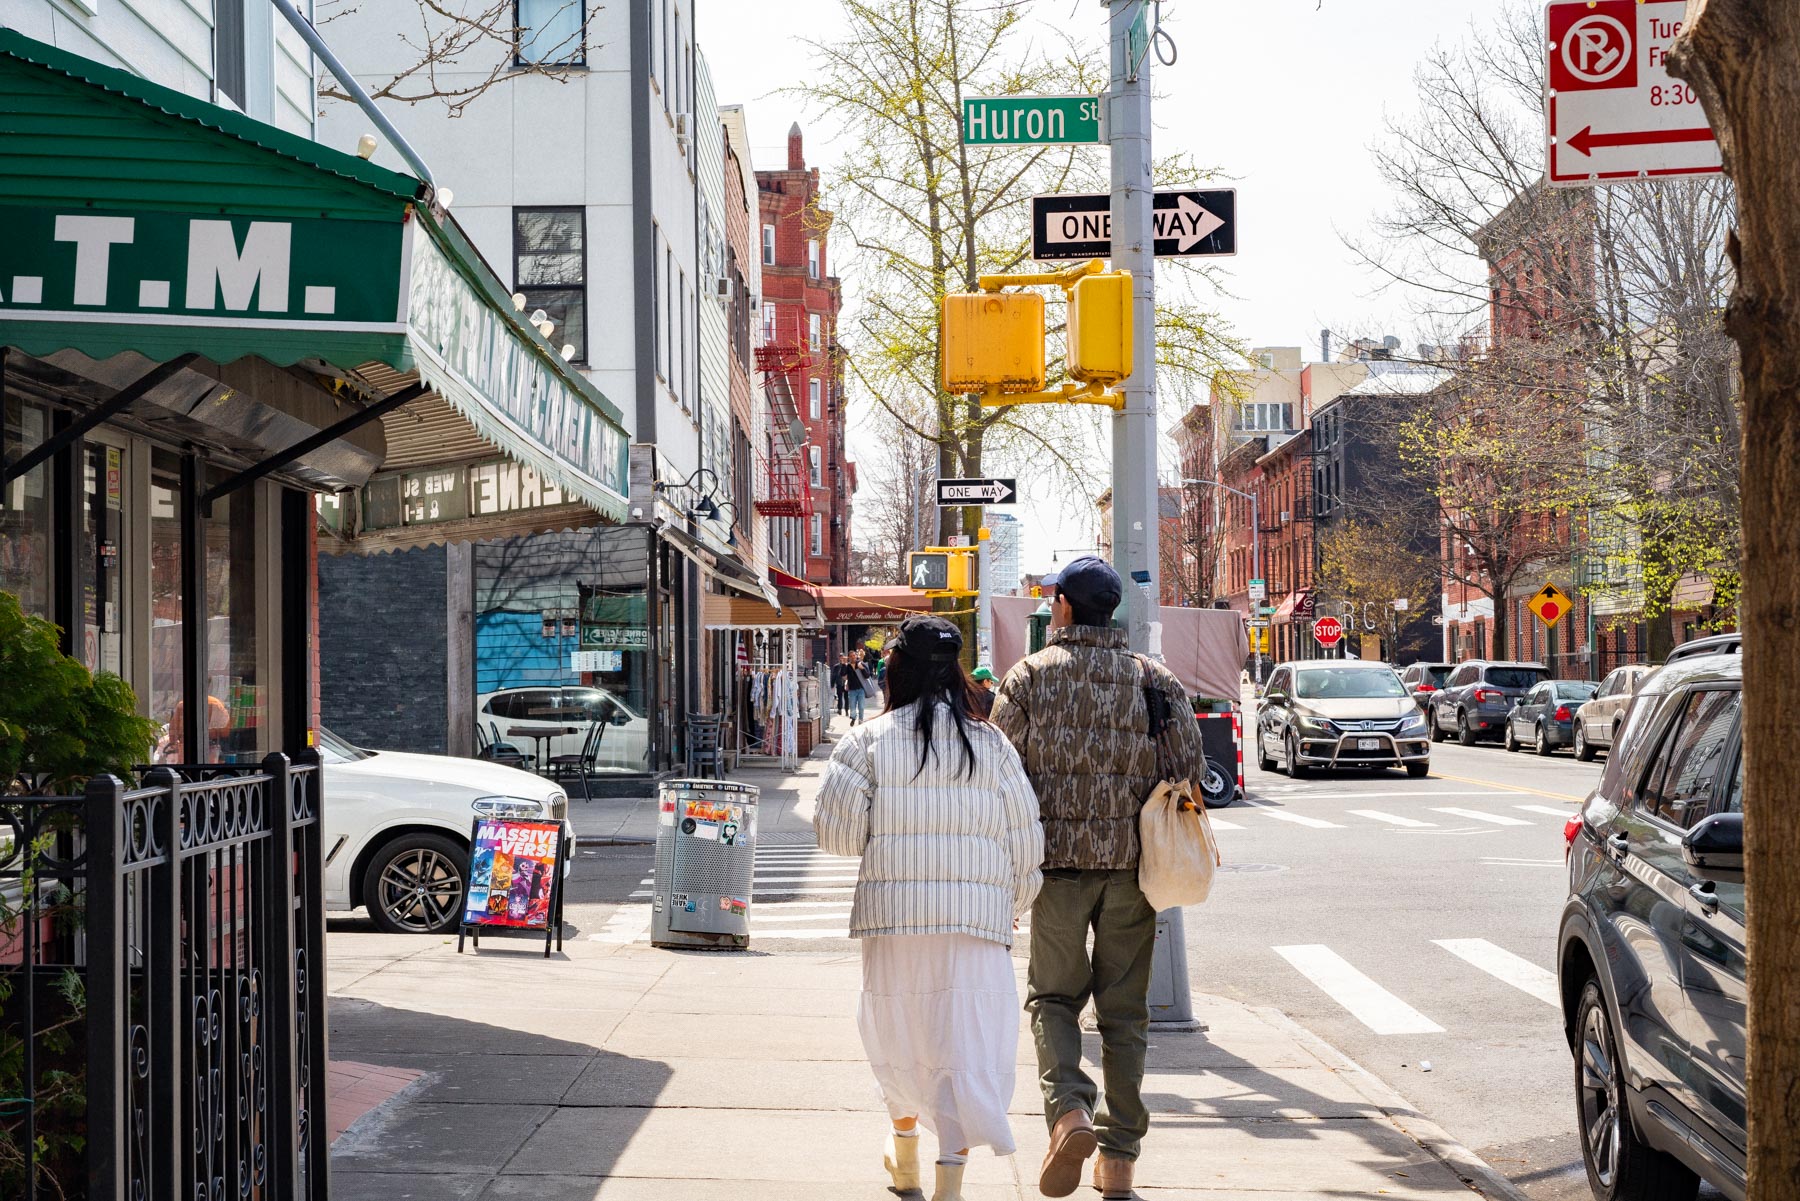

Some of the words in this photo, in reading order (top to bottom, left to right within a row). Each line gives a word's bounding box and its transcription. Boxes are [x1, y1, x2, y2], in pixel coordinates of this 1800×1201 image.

[1649, 18, 1683, 39] Tue
[1649, 47, 1667, 67] Fr
[1650, 84, 1698, 106] 8:30
[968, 103, 1065, 140] Huron
[1079, 102, 1098, 121] St
[1062, 215, 1111, 240] ONE
[1152, 211, 1204, 237] WAY
[0, 214, 336, 316] .T.M.
[948, 487, 970, 497] ONE
[981, 487, 1004, 497] WAY
[854, 611, 882, 620] Franklin
[884, 611, 904, 620] Street
[1315, 625, 1341, 637] STOP
[476, 826, 559, 845] MASSIVE
[493, 840, 557, 858] -VERSE
